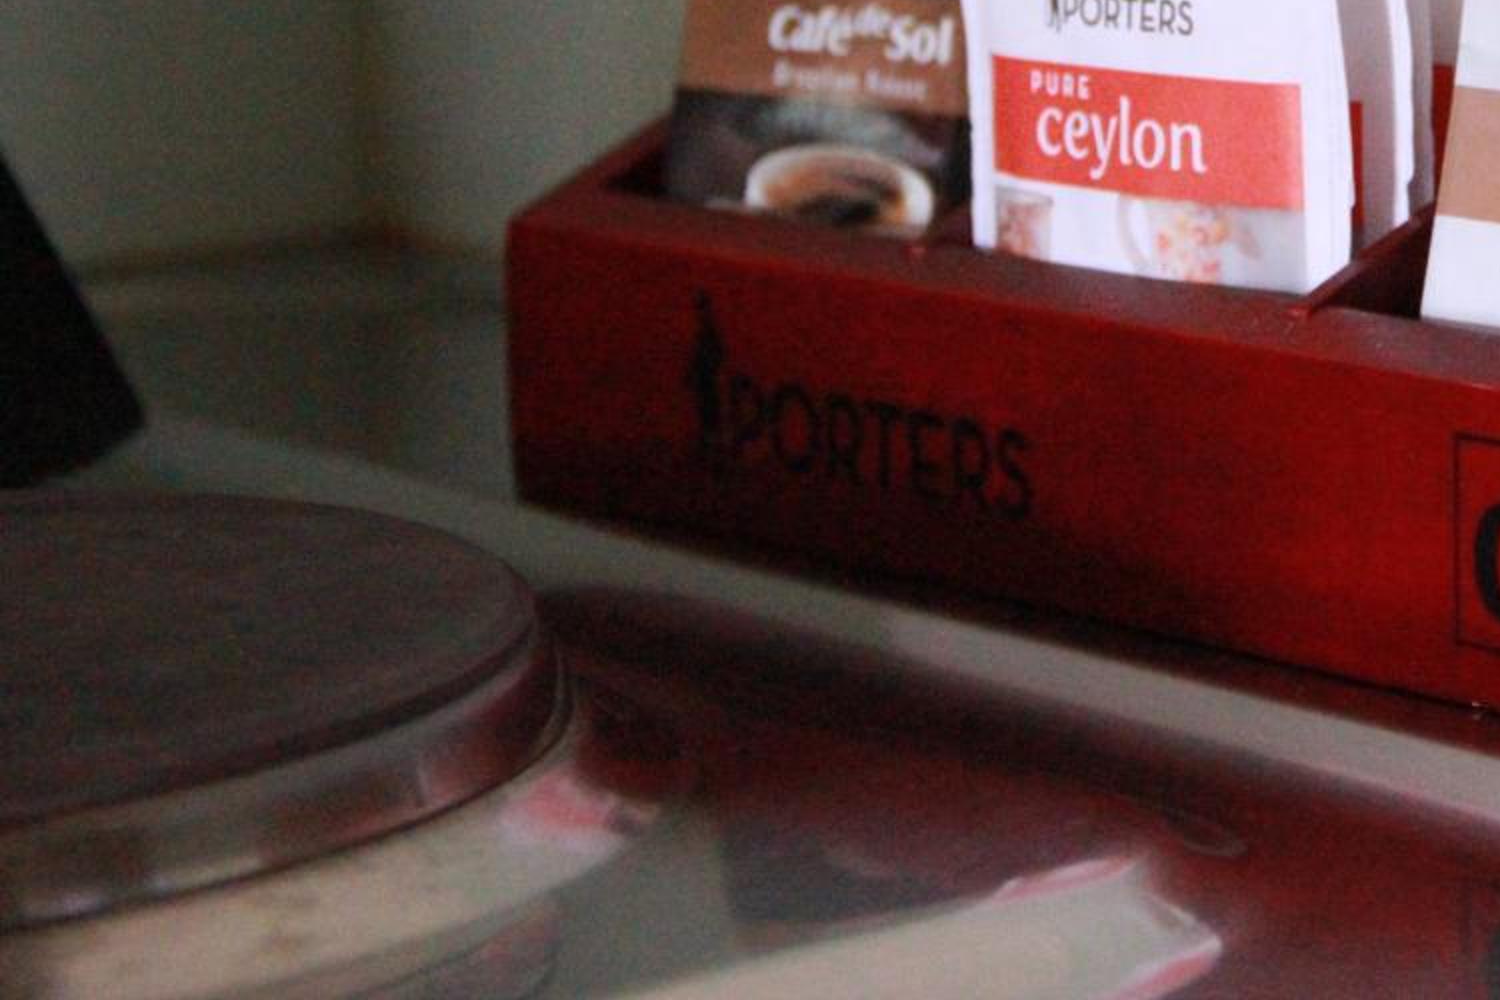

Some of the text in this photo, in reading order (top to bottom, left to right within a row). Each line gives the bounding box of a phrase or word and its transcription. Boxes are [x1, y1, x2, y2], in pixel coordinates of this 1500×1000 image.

[885, 14, 955, 67] Sol
[1029, 69, 1090, 100] PURE
[1036, 94, 1207, 180] ceylon
[727, 374, 1034, 523] PORTERS
